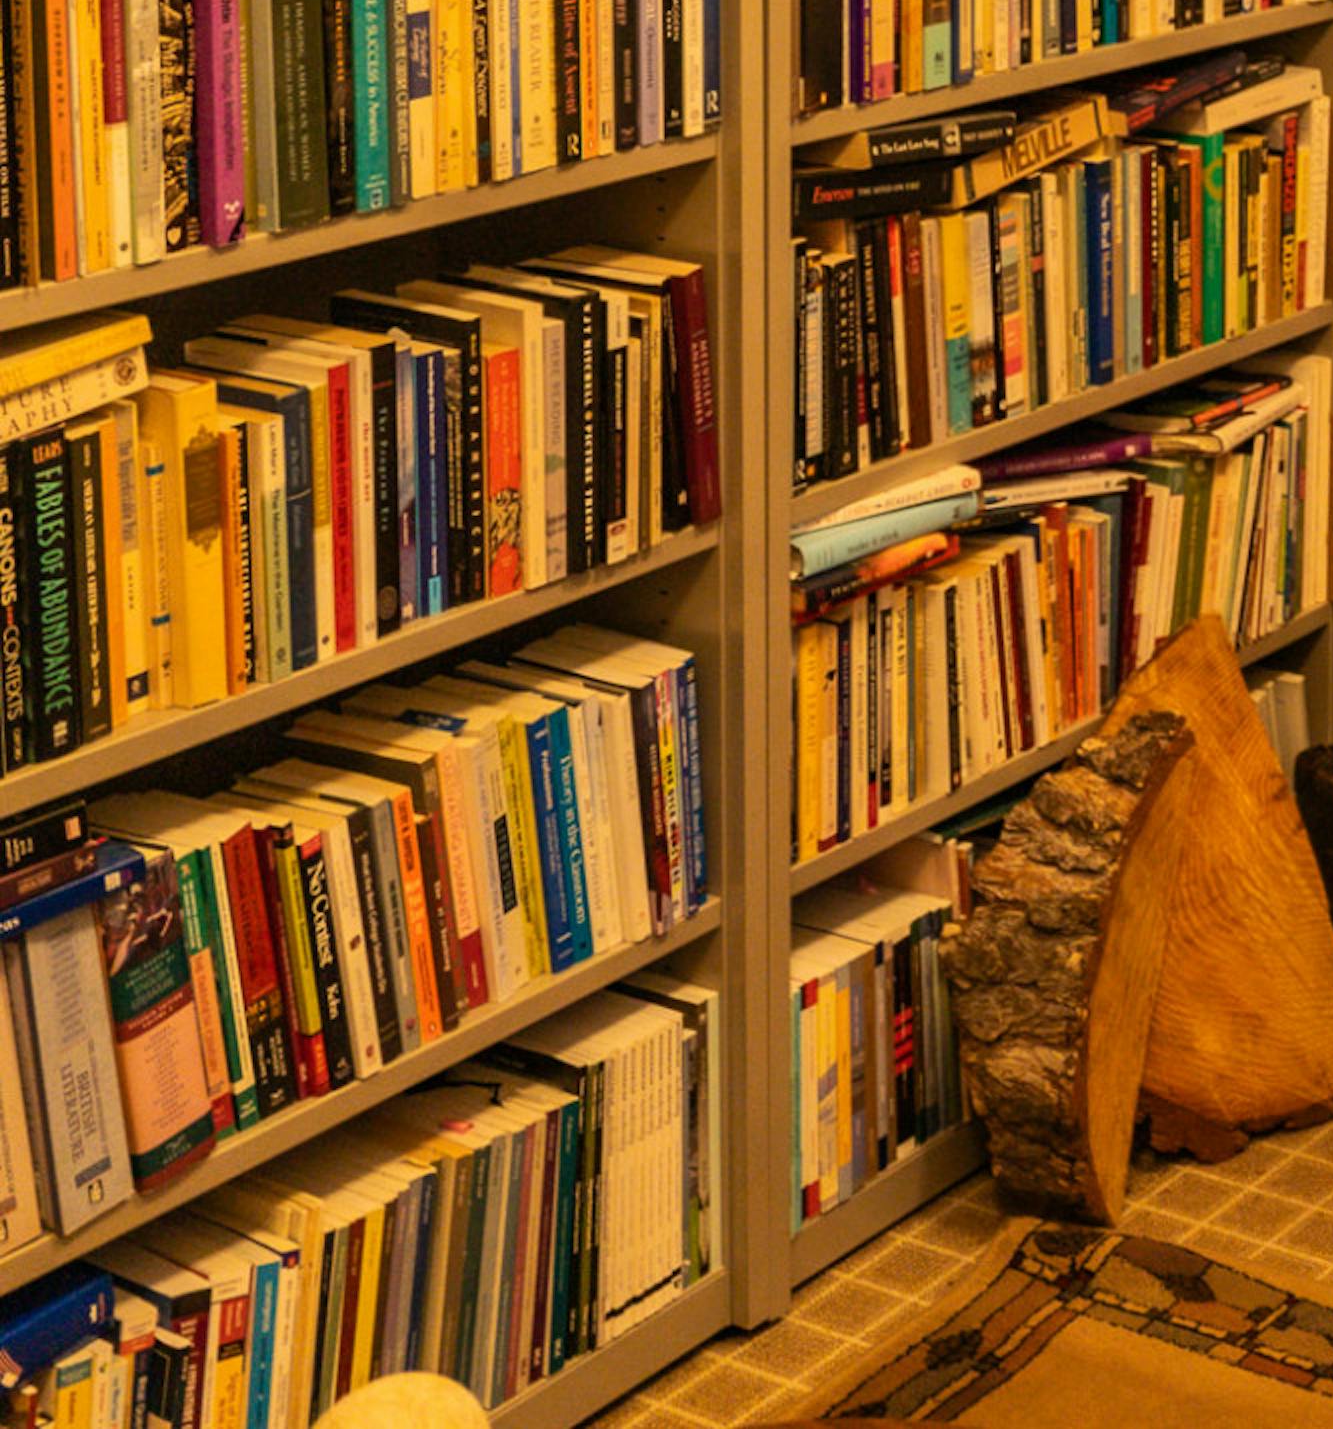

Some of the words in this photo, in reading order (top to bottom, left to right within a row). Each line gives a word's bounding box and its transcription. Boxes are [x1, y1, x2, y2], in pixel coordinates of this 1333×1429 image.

[1001, 117, 1073, 179] MELVILLE
[32, 465, 66, 547] FABLES
[469, 432, 483, 557] AMERICA
[0, 508, 18, 607] CANONS
[39, 549, 64, 575] OF
[3, 624, 23, 720] CONTEXTS
[37, 578, 74, 713] ABUNDANCE
[306, 859, 325, 895] No
[311, 895, 334, 969] Contest
[60, 1061, 86, 1164] LITERATURE
[75, 1069, 98, 1137] BRITISH
